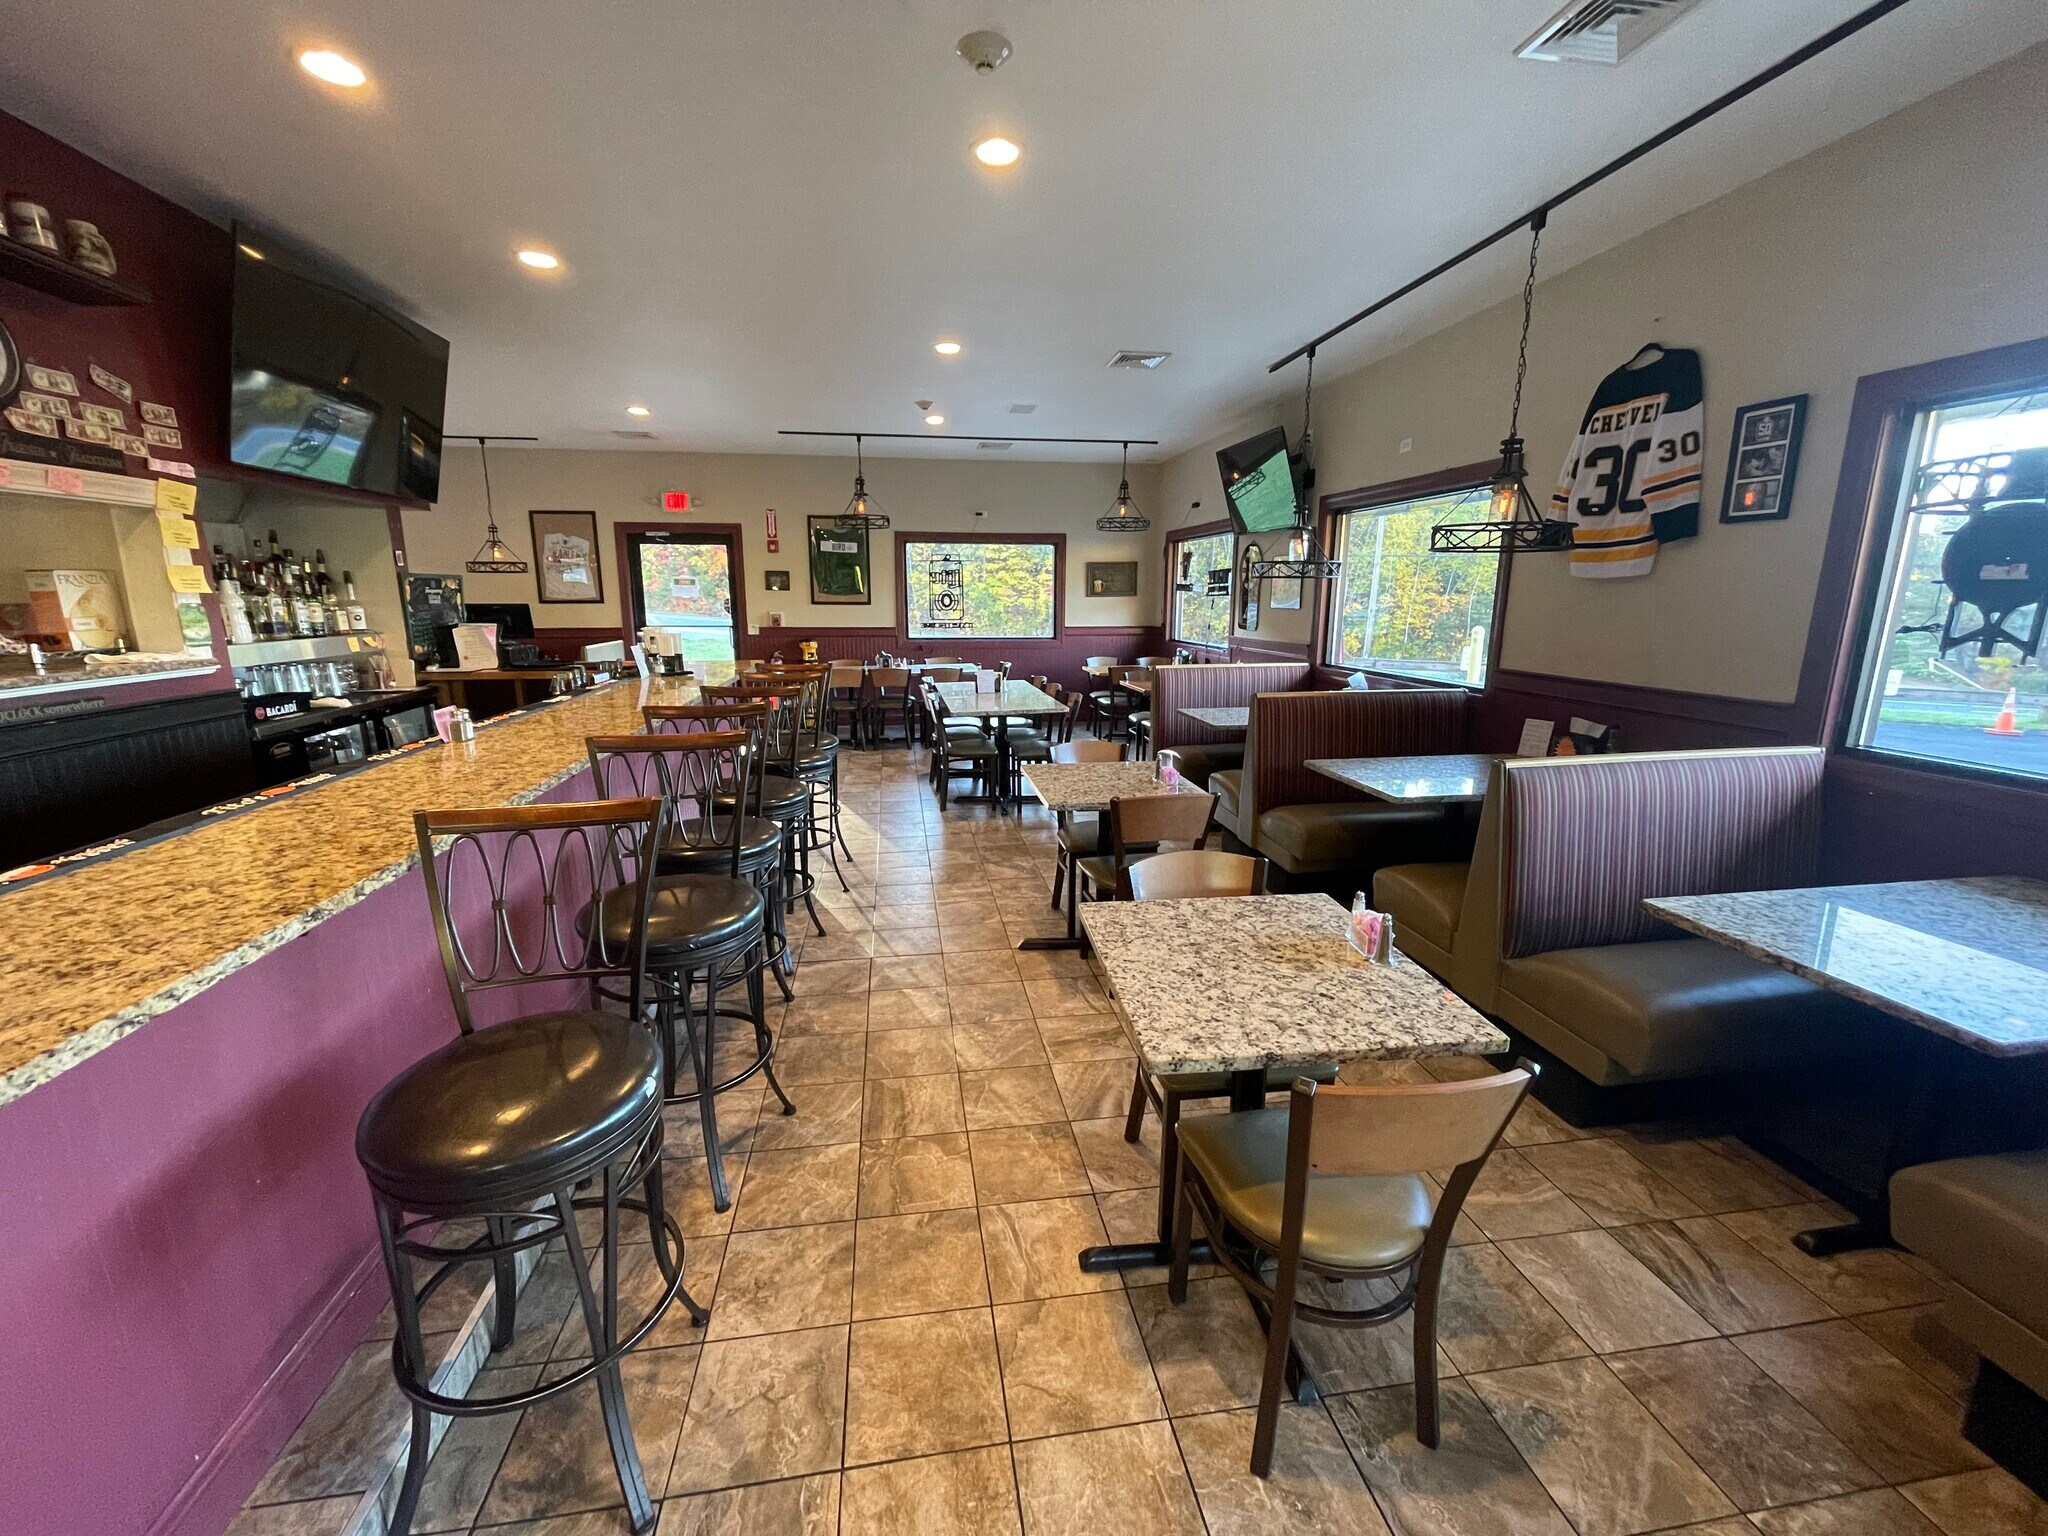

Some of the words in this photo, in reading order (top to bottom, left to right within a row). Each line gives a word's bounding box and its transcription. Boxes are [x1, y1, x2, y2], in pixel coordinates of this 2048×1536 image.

[1656, 431, 1700, 463] 30
[57, 574, 108, 588] FRANZIA
[43, 699, 105, 715] somewhere
